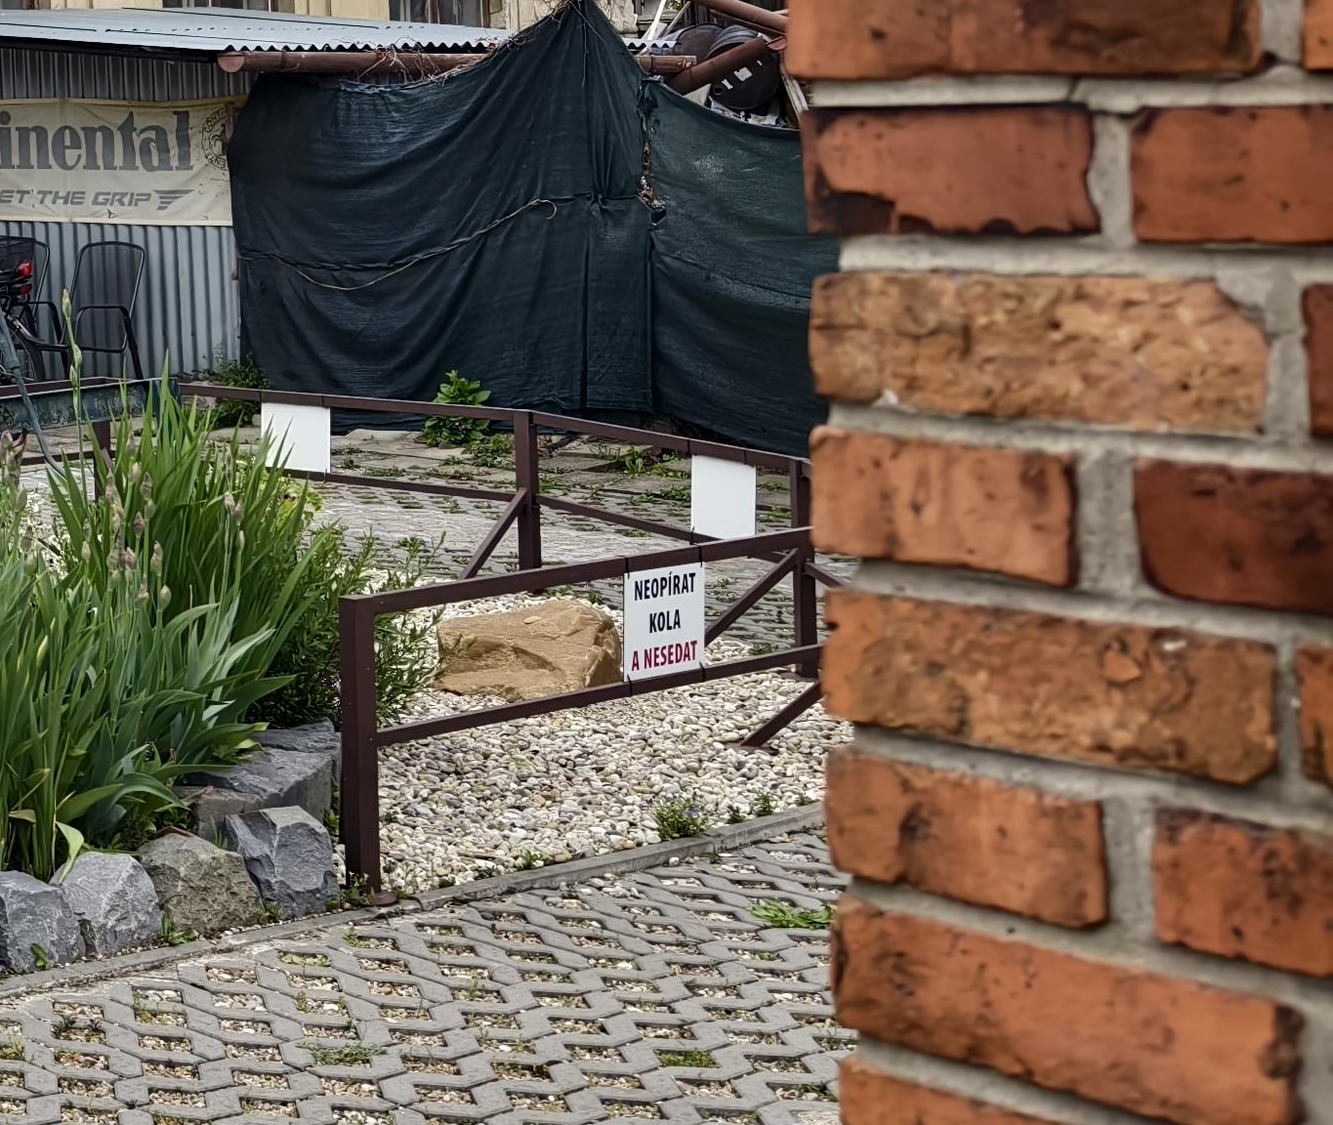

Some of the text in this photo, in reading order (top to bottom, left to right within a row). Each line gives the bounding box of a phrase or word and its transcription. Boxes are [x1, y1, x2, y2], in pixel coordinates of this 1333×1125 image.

[37, 190, 86, 205] THE
[91, 191, 153, 207] GRIP
[634, 571, 696, 601] NEOPÍRAT
[649, 609, 681, 633] KOLA
[631, 640, 698, 672] A NESEDAT
